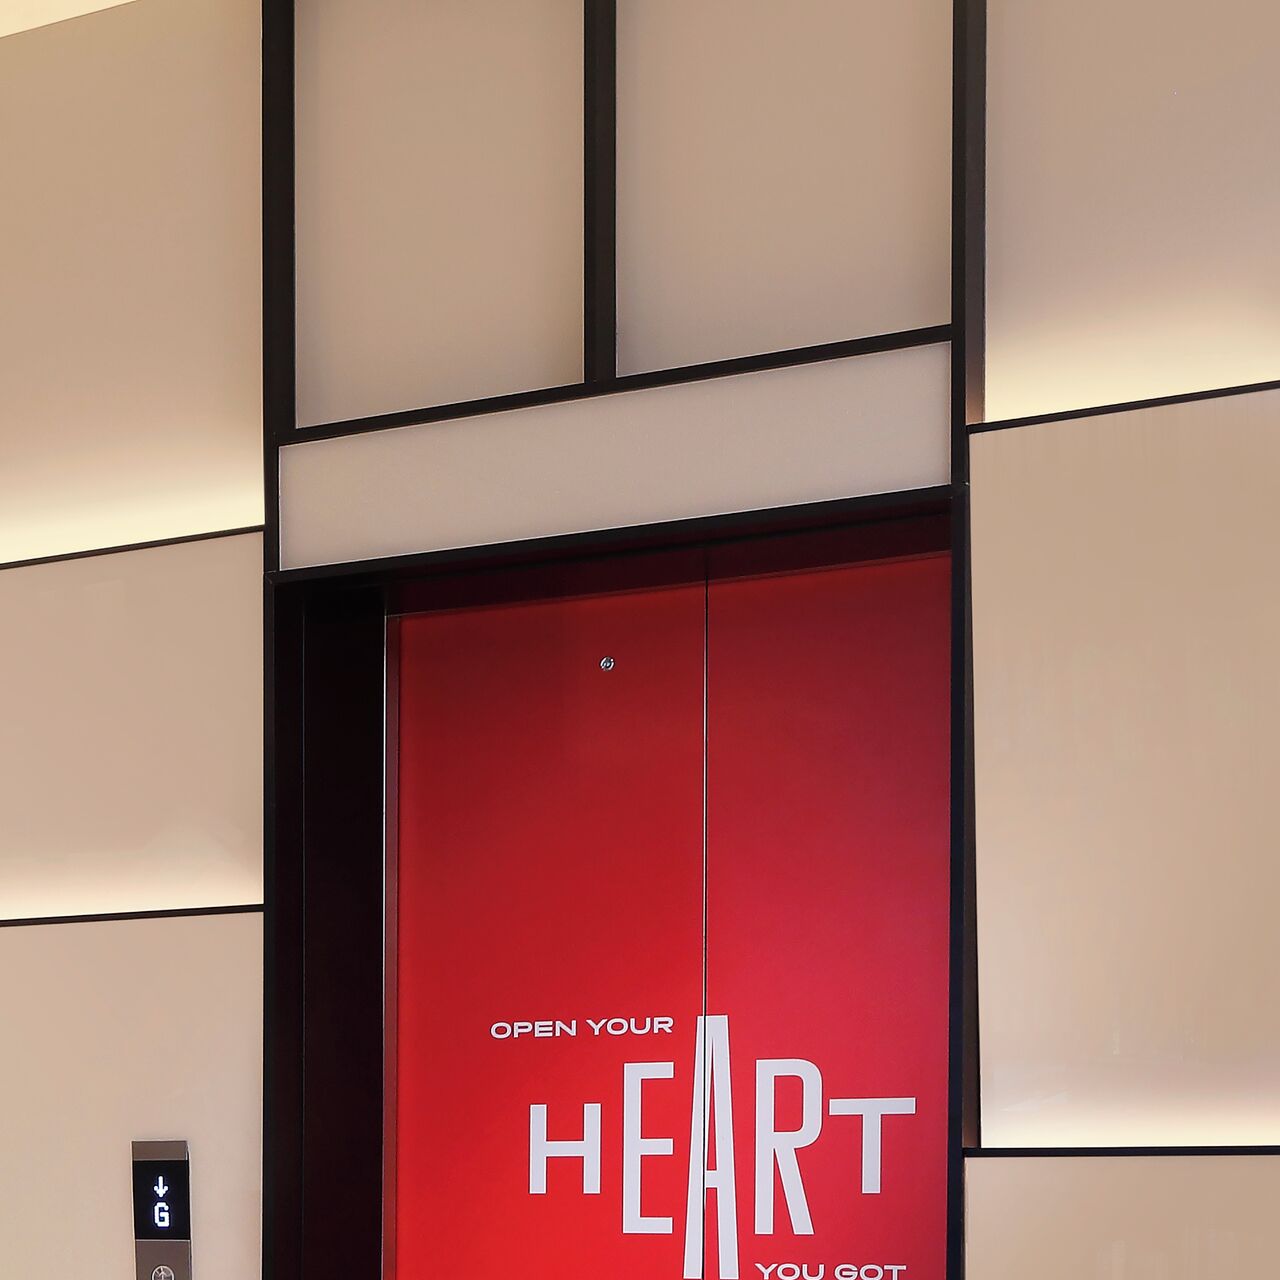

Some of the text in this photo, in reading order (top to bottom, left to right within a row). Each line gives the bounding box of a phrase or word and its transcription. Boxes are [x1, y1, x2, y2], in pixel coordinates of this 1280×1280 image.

[490, 1016, 674, 1039] OPEN YOUR
[529, 1014, 916, 1280] HEART
[153, 1201, 170, 1228] G
